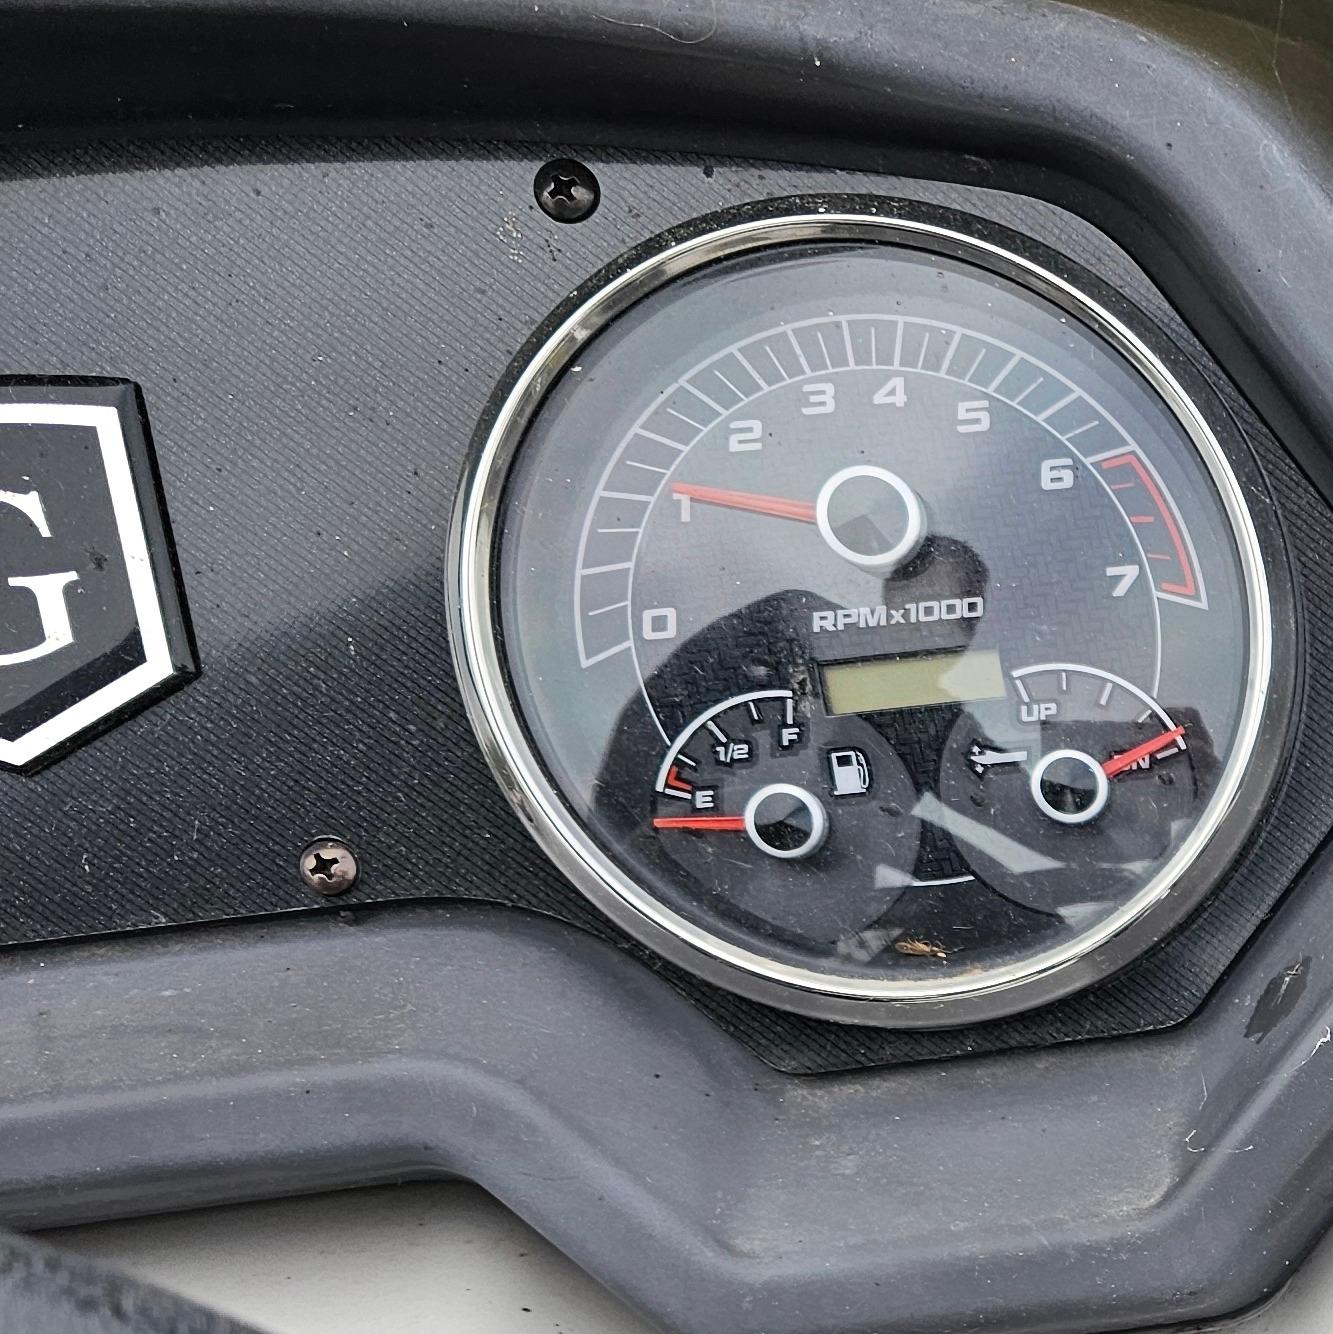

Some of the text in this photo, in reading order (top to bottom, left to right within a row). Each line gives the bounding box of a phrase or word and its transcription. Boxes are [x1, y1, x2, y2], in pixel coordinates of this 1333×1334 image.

[801, 382, 835, 415] 3
[873, 377, 907, 407] 4
[956, 400, 990, 433] 5
[729, 420, 762, 452] 2
[1040, 458, 1074, 490] 6
[672, 492, 691, 522] 1
[1106, 565, 1139, 597] 7
[642, 607, 676, 640] 0
[813, 596, 984, 633] RPMx1000
[1021, 703, 1057, 722] UP
[715, 743, 749, 762] 1/2
[782, 728, 800, 746] F
[1113, 754, 1150, 770] N
[695, 790, 714, 808] E
